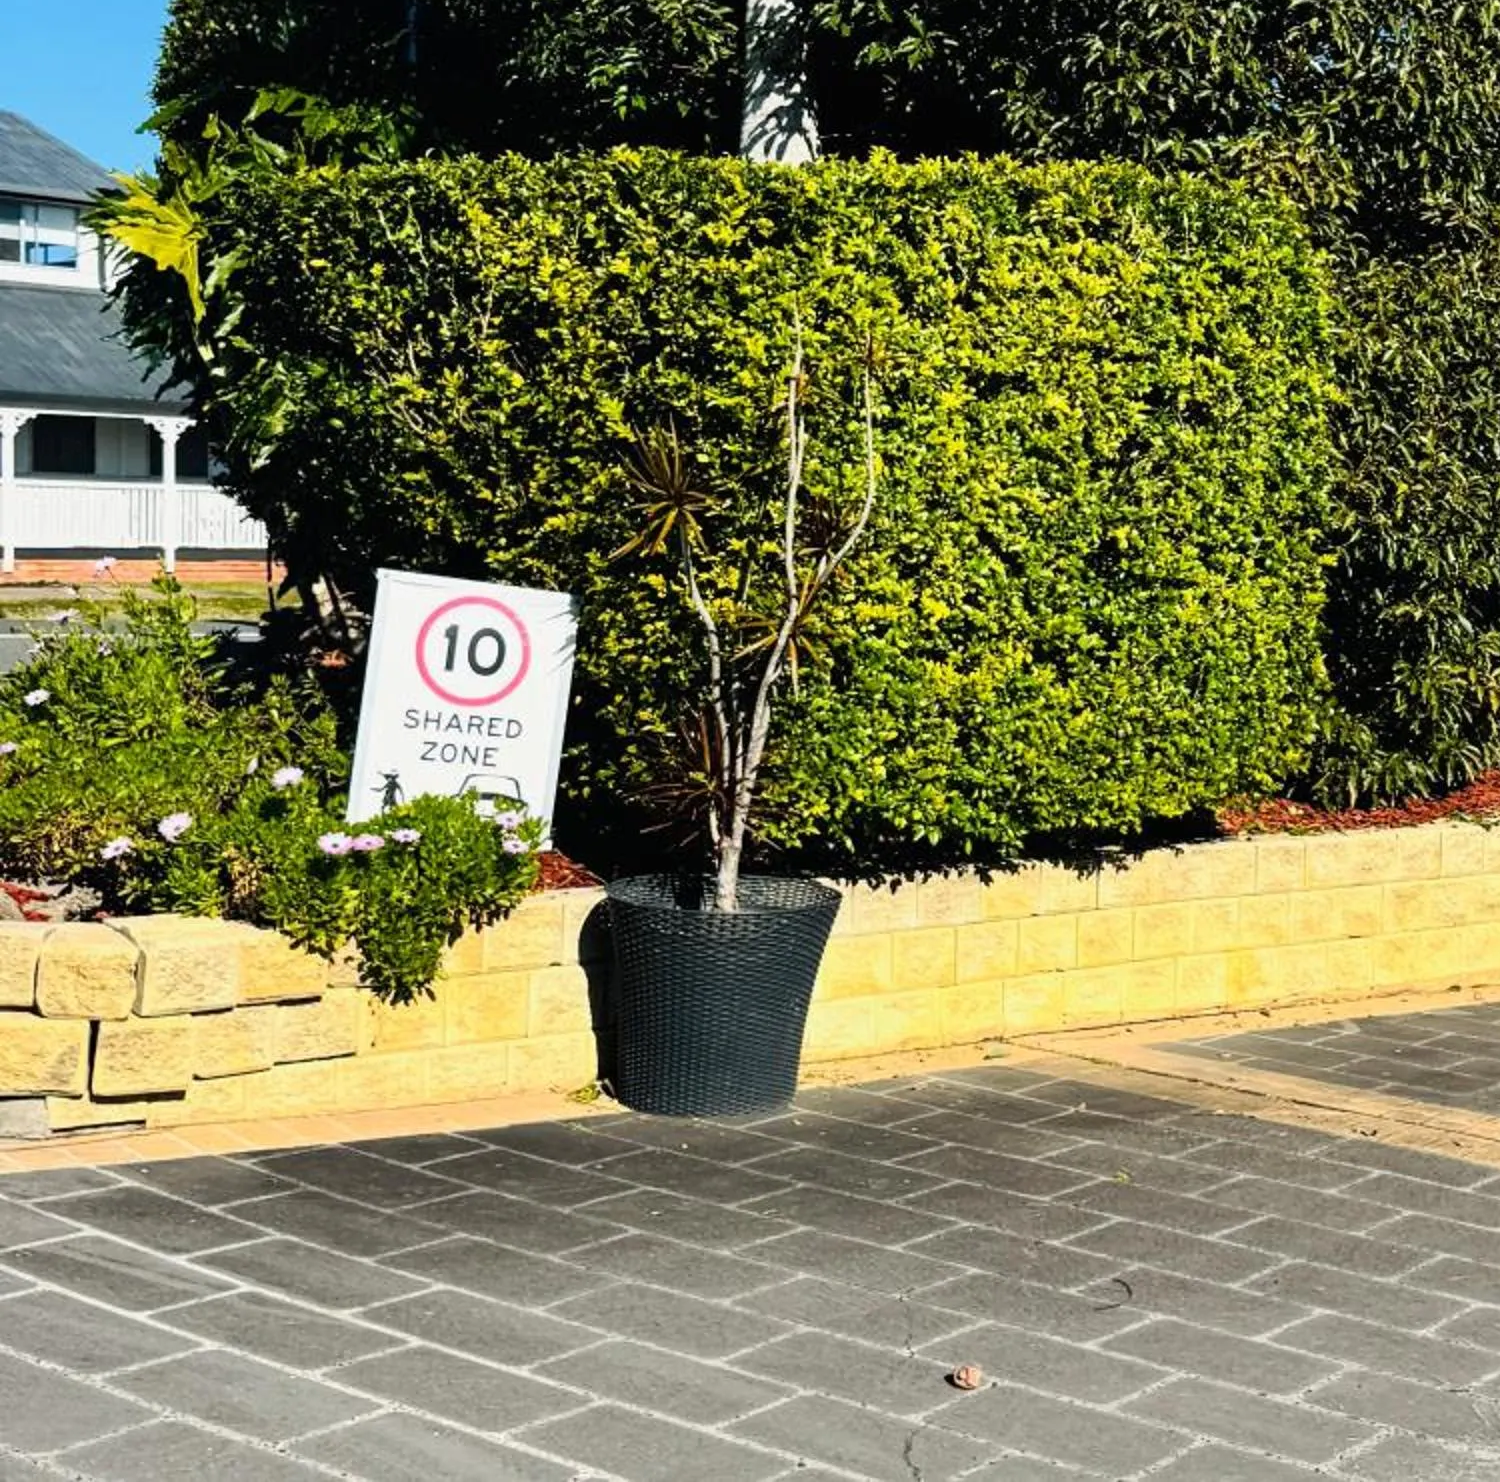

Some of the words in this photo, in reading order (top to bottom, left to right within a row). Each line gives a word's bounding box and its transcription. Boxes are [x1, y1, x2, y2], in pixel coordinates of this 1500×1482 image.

[443, 624, 506, 676] 10
[403, 709, 523, 739] SHARED
[420, 741, 499, 767] ZONE
